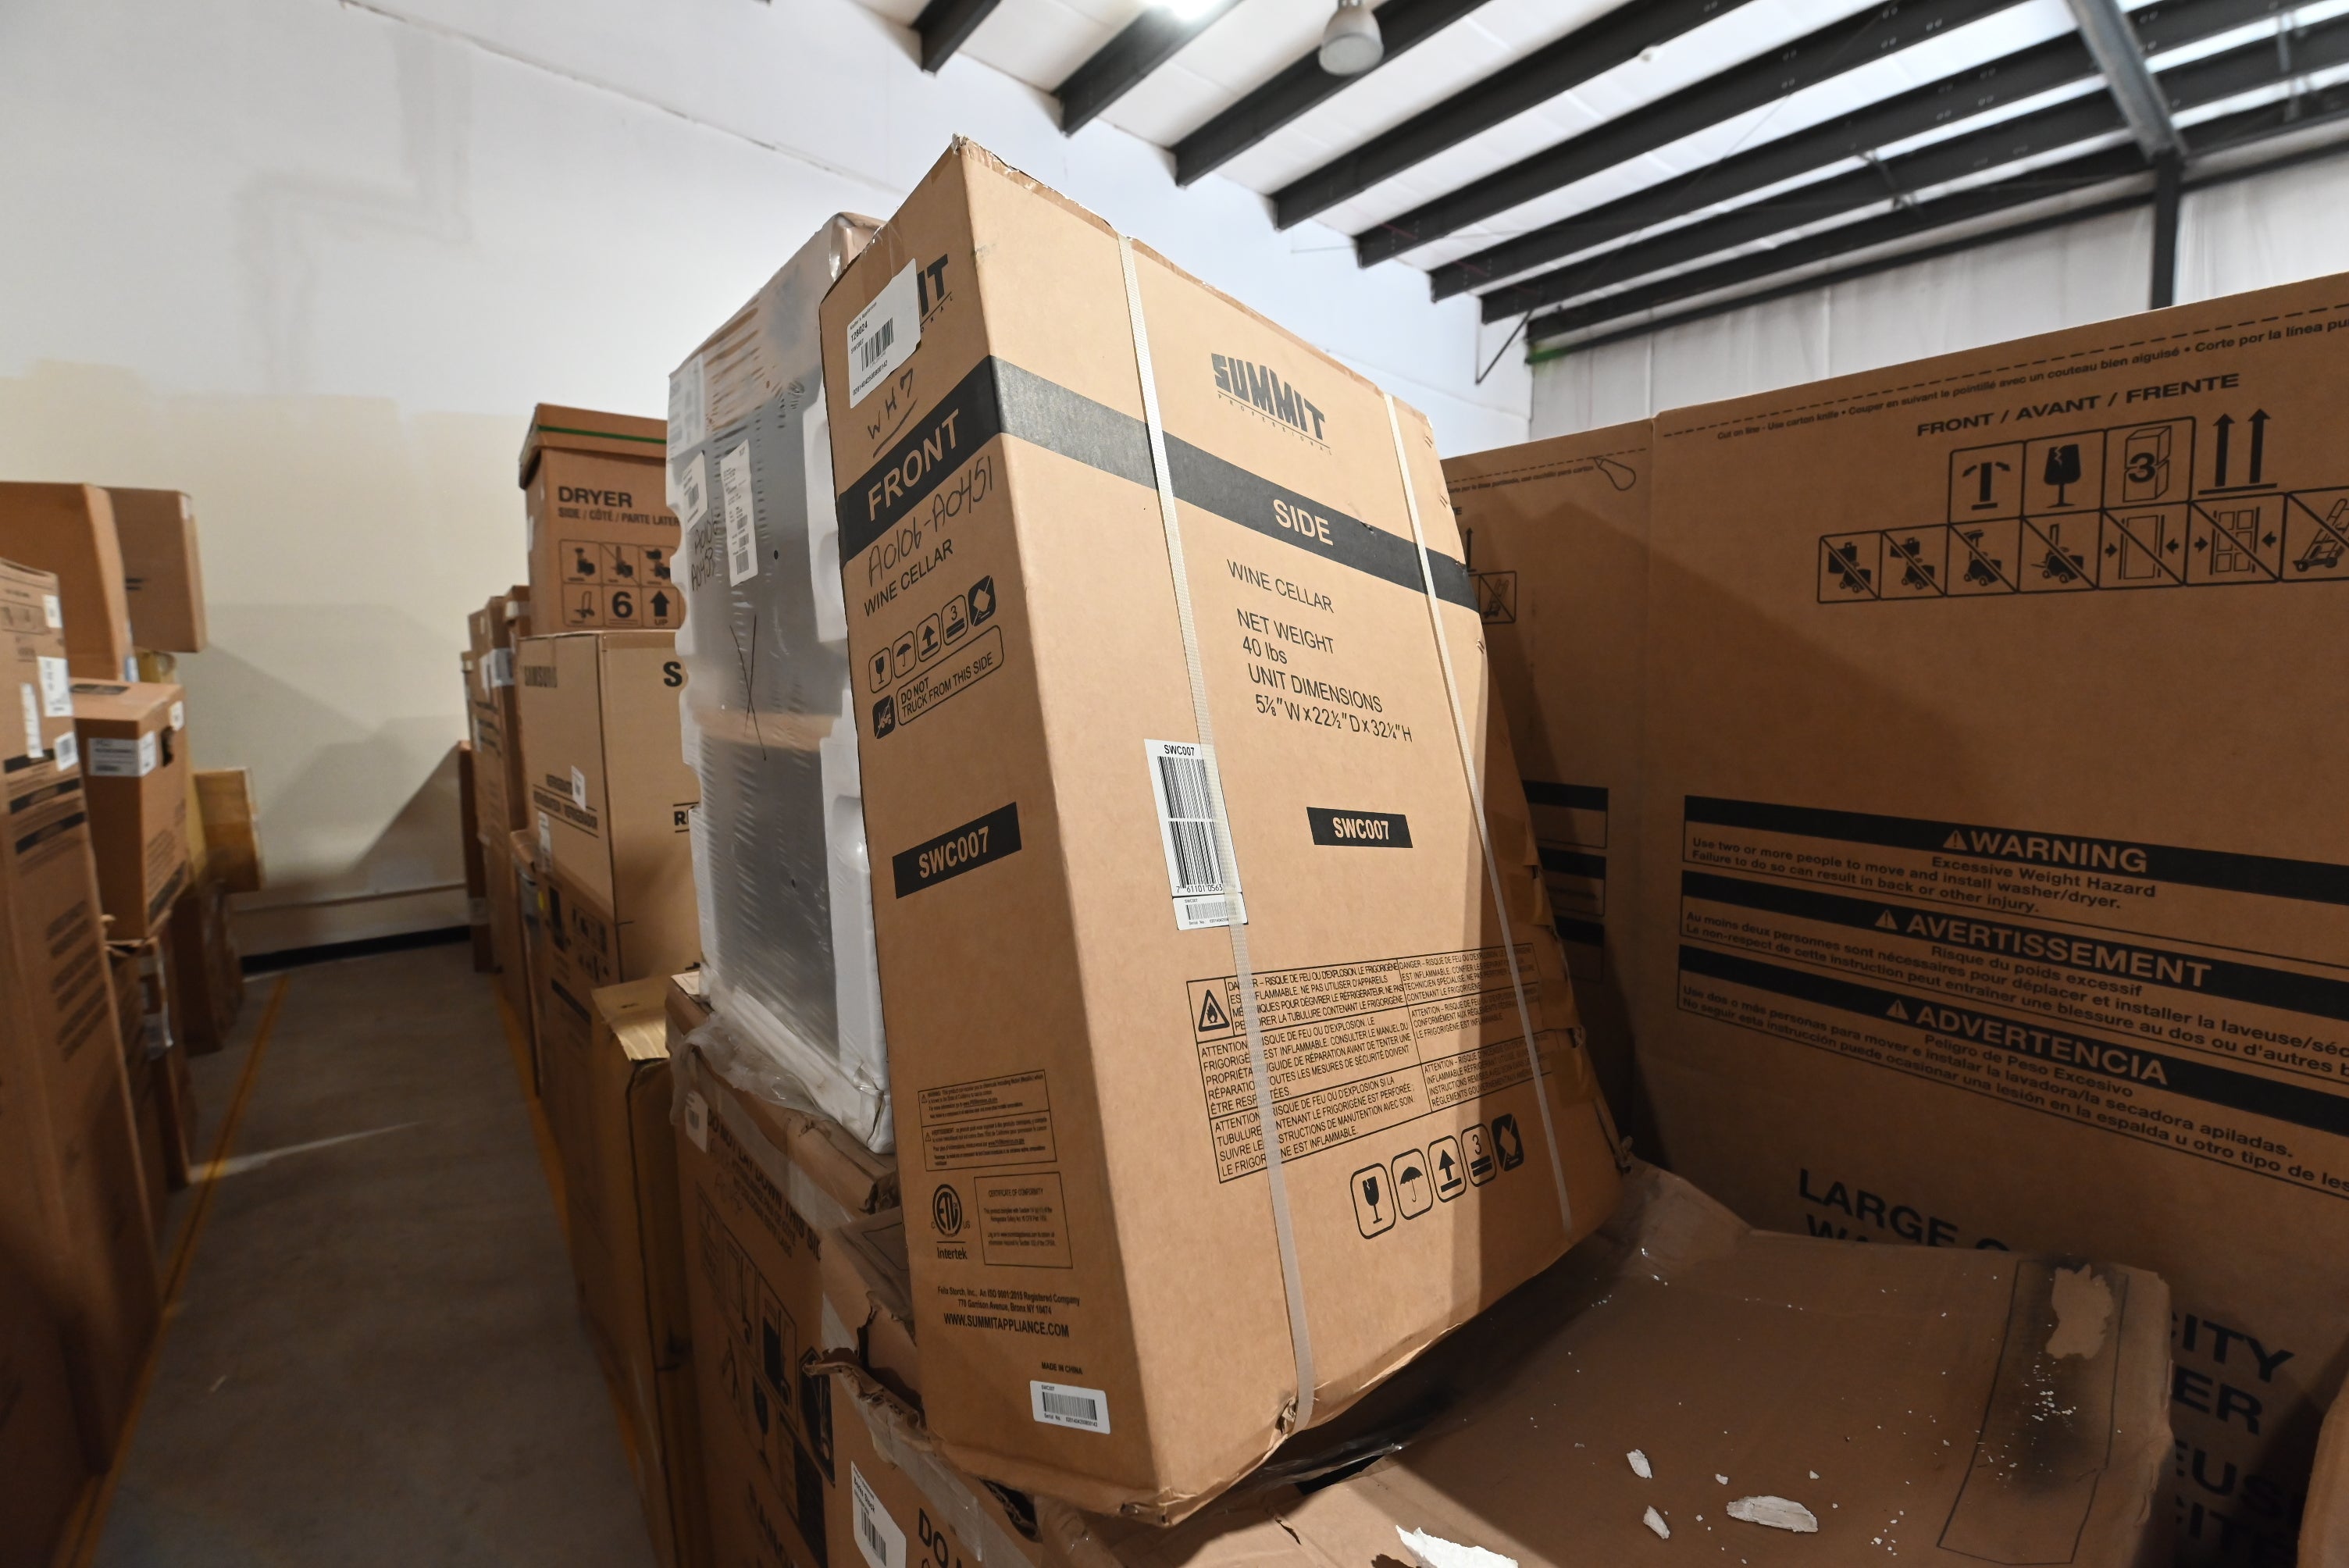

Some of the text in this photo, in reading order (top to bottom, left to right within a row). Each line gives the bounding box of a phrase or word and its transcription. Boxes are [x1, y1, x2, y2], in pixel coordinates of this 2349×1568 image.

[850, 320, 868, 342] 128024
[1745, 425, 1759, 434] line
[1768, 422, 1784, 430] Use
[1787, 415, 1815, 427] carton
[1816, 408, 1839, 422] knife
[1848, 401, 1884, 416] Couper
[1901, 391, 1938, 406] suivant
[1952, 380, 1996, 399] pointillé
[1998, 376, 2027, 388] avec
[2030, 372, 2044, 382] un
[2047, 362, 2098, 380] couteau
[2101, 356, 2128, 370] bien
[2131, 346, 2180, 365] aiguisé
[2194, 338, 2234, 353] Corte
[2238, 332, 2264, 347] por
[2268, 326, 2281, 341] la
[2285, 321, 2322, 337] línea
[1211, 352, 1325, 440] SUMMIT
[1916, 372, 2240, 437] FRONT AVANT FRENTE
[868, 408, 959, 522] FRONT
[2127, 452, 2159, 483] 3
[558, 486, 633, 508] DRYER
[558, 507, 579, 519] SIDE
[621, 513, 651, 525] PARTE
[652, 515, 680, 526] LATER
[1273, 499, 1334, 546] SIDE
[864, 538, 954, 617] WINE CELLAR
[1227, 558, 1334, 614] WINE CELLAR
[611, 591, 633, 618] 6
[950, 604, 958, 621] 3
[1237, 608, 1334, 654] NET WEIGHT
[1242, 636, 1288, 665] 40 lbs
[900, 677, 929, 704] DO NOT
[901, 652, 993, 718] TRUCK FROM THIS SIDE
[1248, 662, 1383, 714] UNIT DIMENSIONS
[1164, 744, 1195, 757] SWC007
[1332, 817, 1389, 840] SWC007
[918, 825, 989, 878] SWC007
[1970, 830, 2148, 874] WARNING
[1207, 883, 1223, 892] 0563
[1692, 837, 2121, 909] Use two or more people to move and install washer/dryer.
[1692, 850, 2040, 914] Failure to do so can result in back or other injury.
[1931, 856, 2156, 898] Excessive Weight Hazard
[1906, 914, 2212, 988] AVERTISSEMENT
[1265, 974, 1289, 986] RISQUE
[1289, 973, 1298, 983] DE
[1299, 971, 1311, 982] FEU
[1312, 971, 1321, 981] OU
[1931, 945, 2142, 997] Risque du poids excessif
[1411, 1006, 1440, 1018] ATTENTION
[1202, 1040, 1248, 1058] ATTENTION
[1305, 1035, 1397, 1064] RÉPARATION AVANT TENTER
[1331, 1032, 1367, 1046] CONSULTER
[1377, 1025, 1399, 1036] MANUEL
[1916, 1006, 2169, 1085] ADVERTENCIA
[1312, 1045, 1410, 1074] MESURES SÉCURITÉ DOIVENT
[1924, 1034, 2133, 1097] Peligro de Peso Excesivo
[1338, 1107, 1383, 1126] MANUTENTION
[1384, 1101, 1399, 1112] AVEC
[1218, 1125, 1261, 1146] TUBULURE
[1472, 1134, 1482, 1156] 3
[1798, 1167, 1959, 1247] LARGE
[937, 1246, 968, 1260] Intertek
[937, 1286, 948, 1295] Felix
[987, 1289, 996, 1298] ISO
[997, 1290, 1023, 1300] 9001:2015
[1024, 1292, 1052, 1303] Registered
[1054, 1293, 1080, 1306] Company
[958, 1299, 1052, 1315] 770 Garrison Avenue, Bronx NY 10474
[943, 1313, 1069, 1338] WWW.SUMMITAPPLIANCE.COM
[2172, 1311, 2295, 1384] ITY
[1042, 1362, 1057, 1371] MADE
[1064, 1365, 1083, 1375] CHINA
